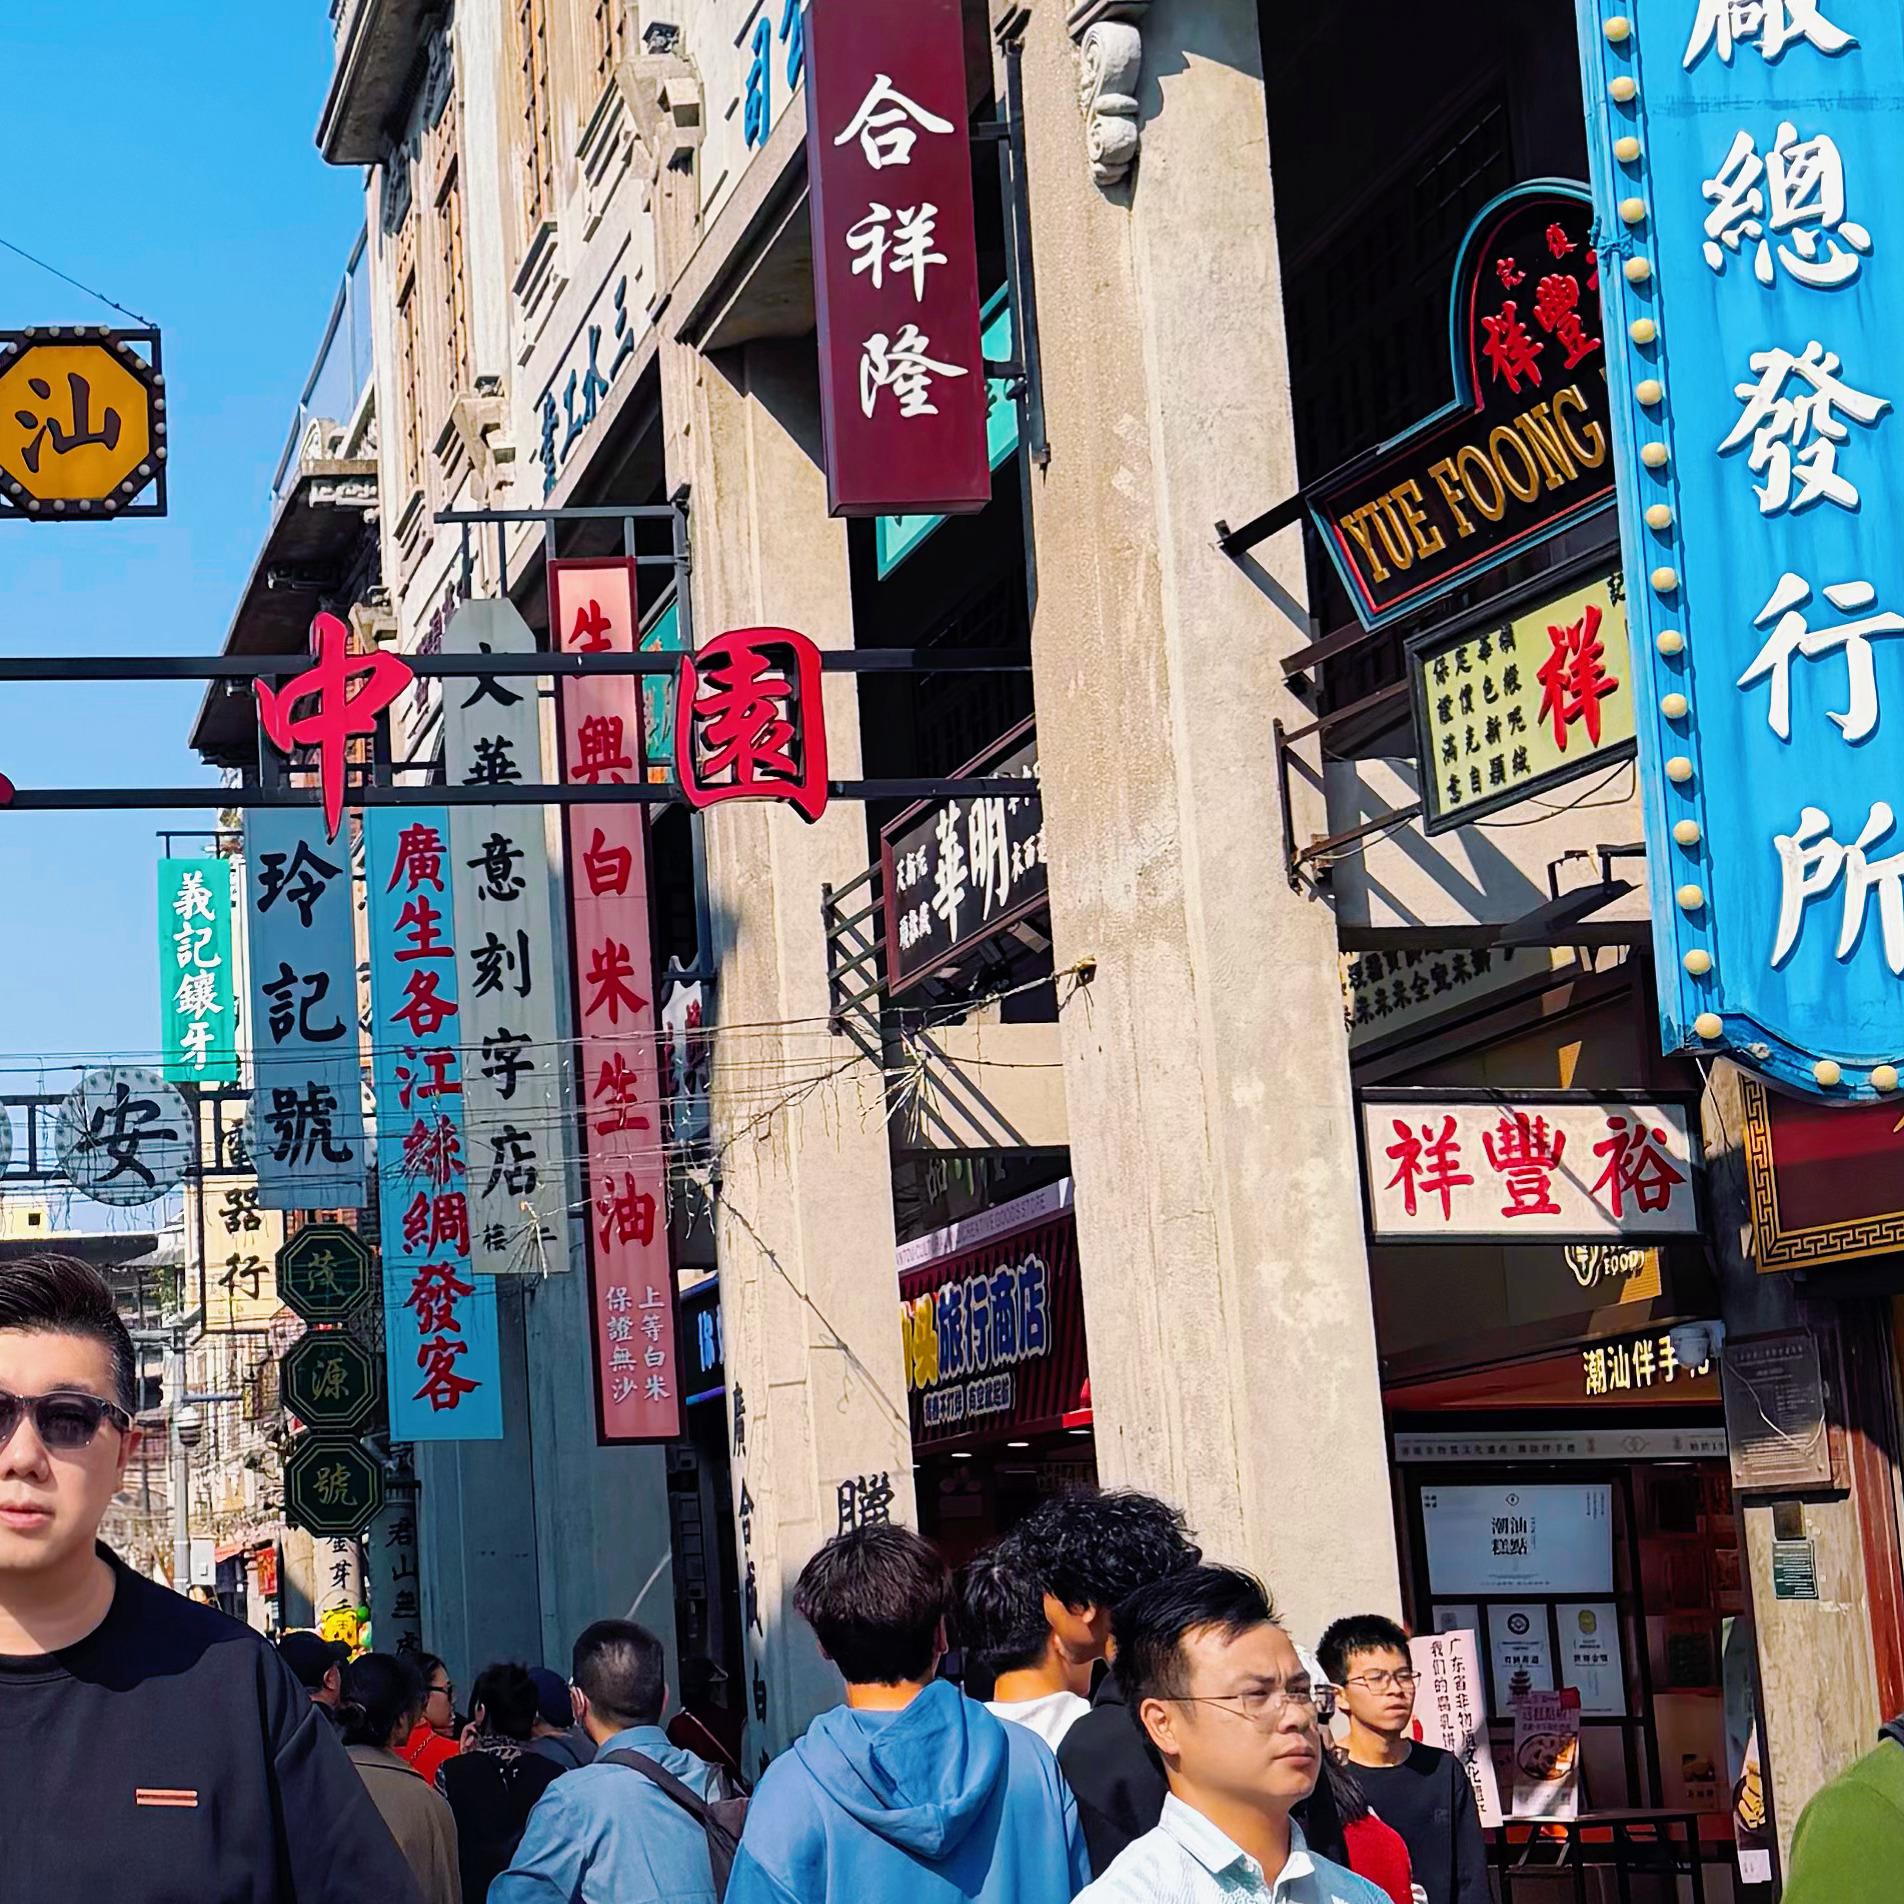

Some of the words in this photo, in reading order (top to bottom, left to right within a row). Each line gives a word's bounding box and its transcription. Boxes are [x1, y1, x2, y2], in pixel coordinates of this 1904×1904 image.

[833, 72, 968, 420] 合祥隆
[1340, 480, 1446, 584] YUE
[1432, 383, 1608, 539] FOONG
[1536, 604, 1620, 753] 祥
[1384, 1111, 1690, 1222] 裕豐祥
[605, 1285, 637, 1406] 保證無沙
[638, 1285, 672, 1401] 上等白米
[901, 1254, 1049, 1391] 头旅行商店
[1582, 1334, 1709, 1396] 潮汕伴手
